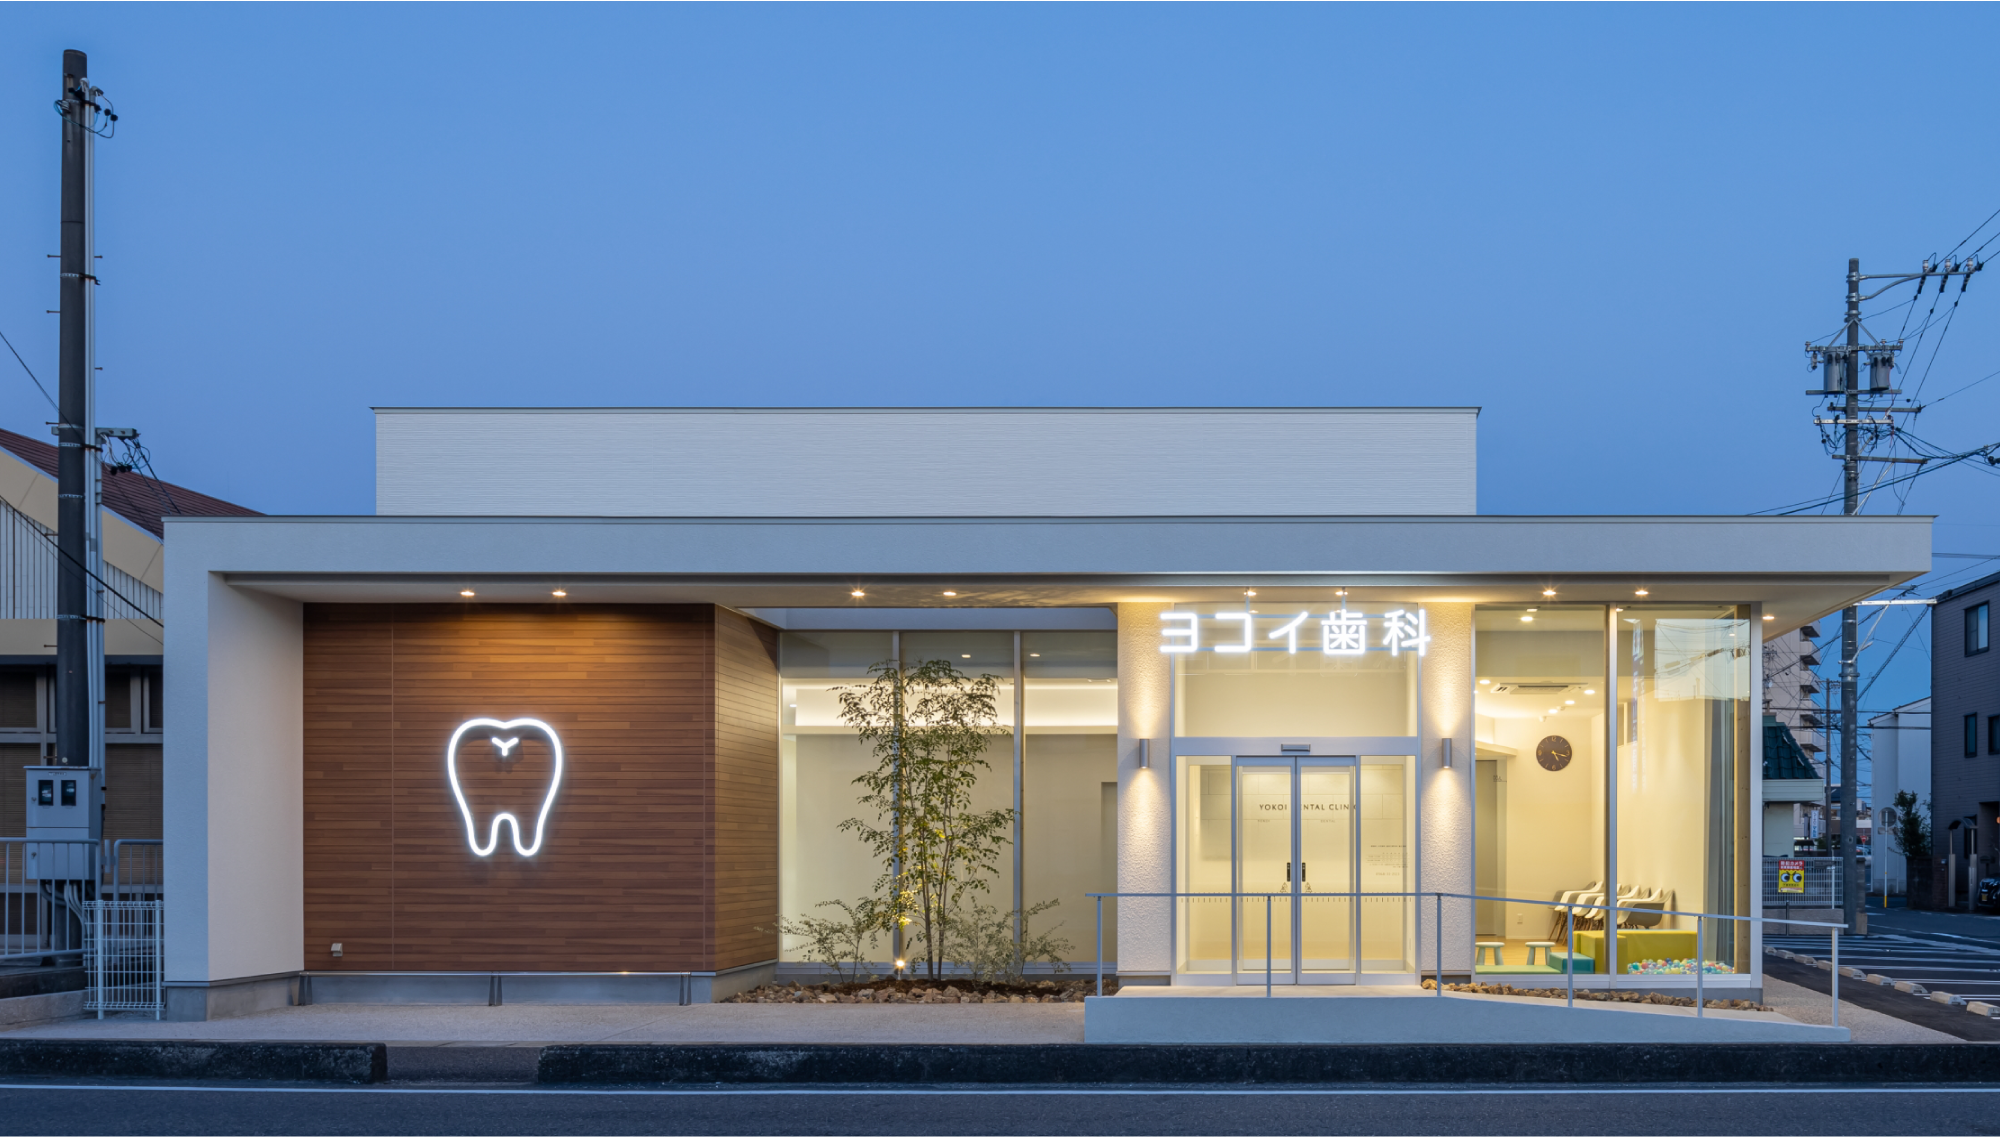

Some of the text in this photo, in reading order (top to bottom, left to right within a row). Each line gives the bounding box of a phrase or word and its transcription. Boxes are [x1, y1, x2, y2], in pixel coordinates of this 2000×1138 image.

[1159, 608, 1431, 657] ヨコイ歯科
[1259, 803, 1288, 811] YOKOI
[1301, 803, 1326, 811] NTAL
